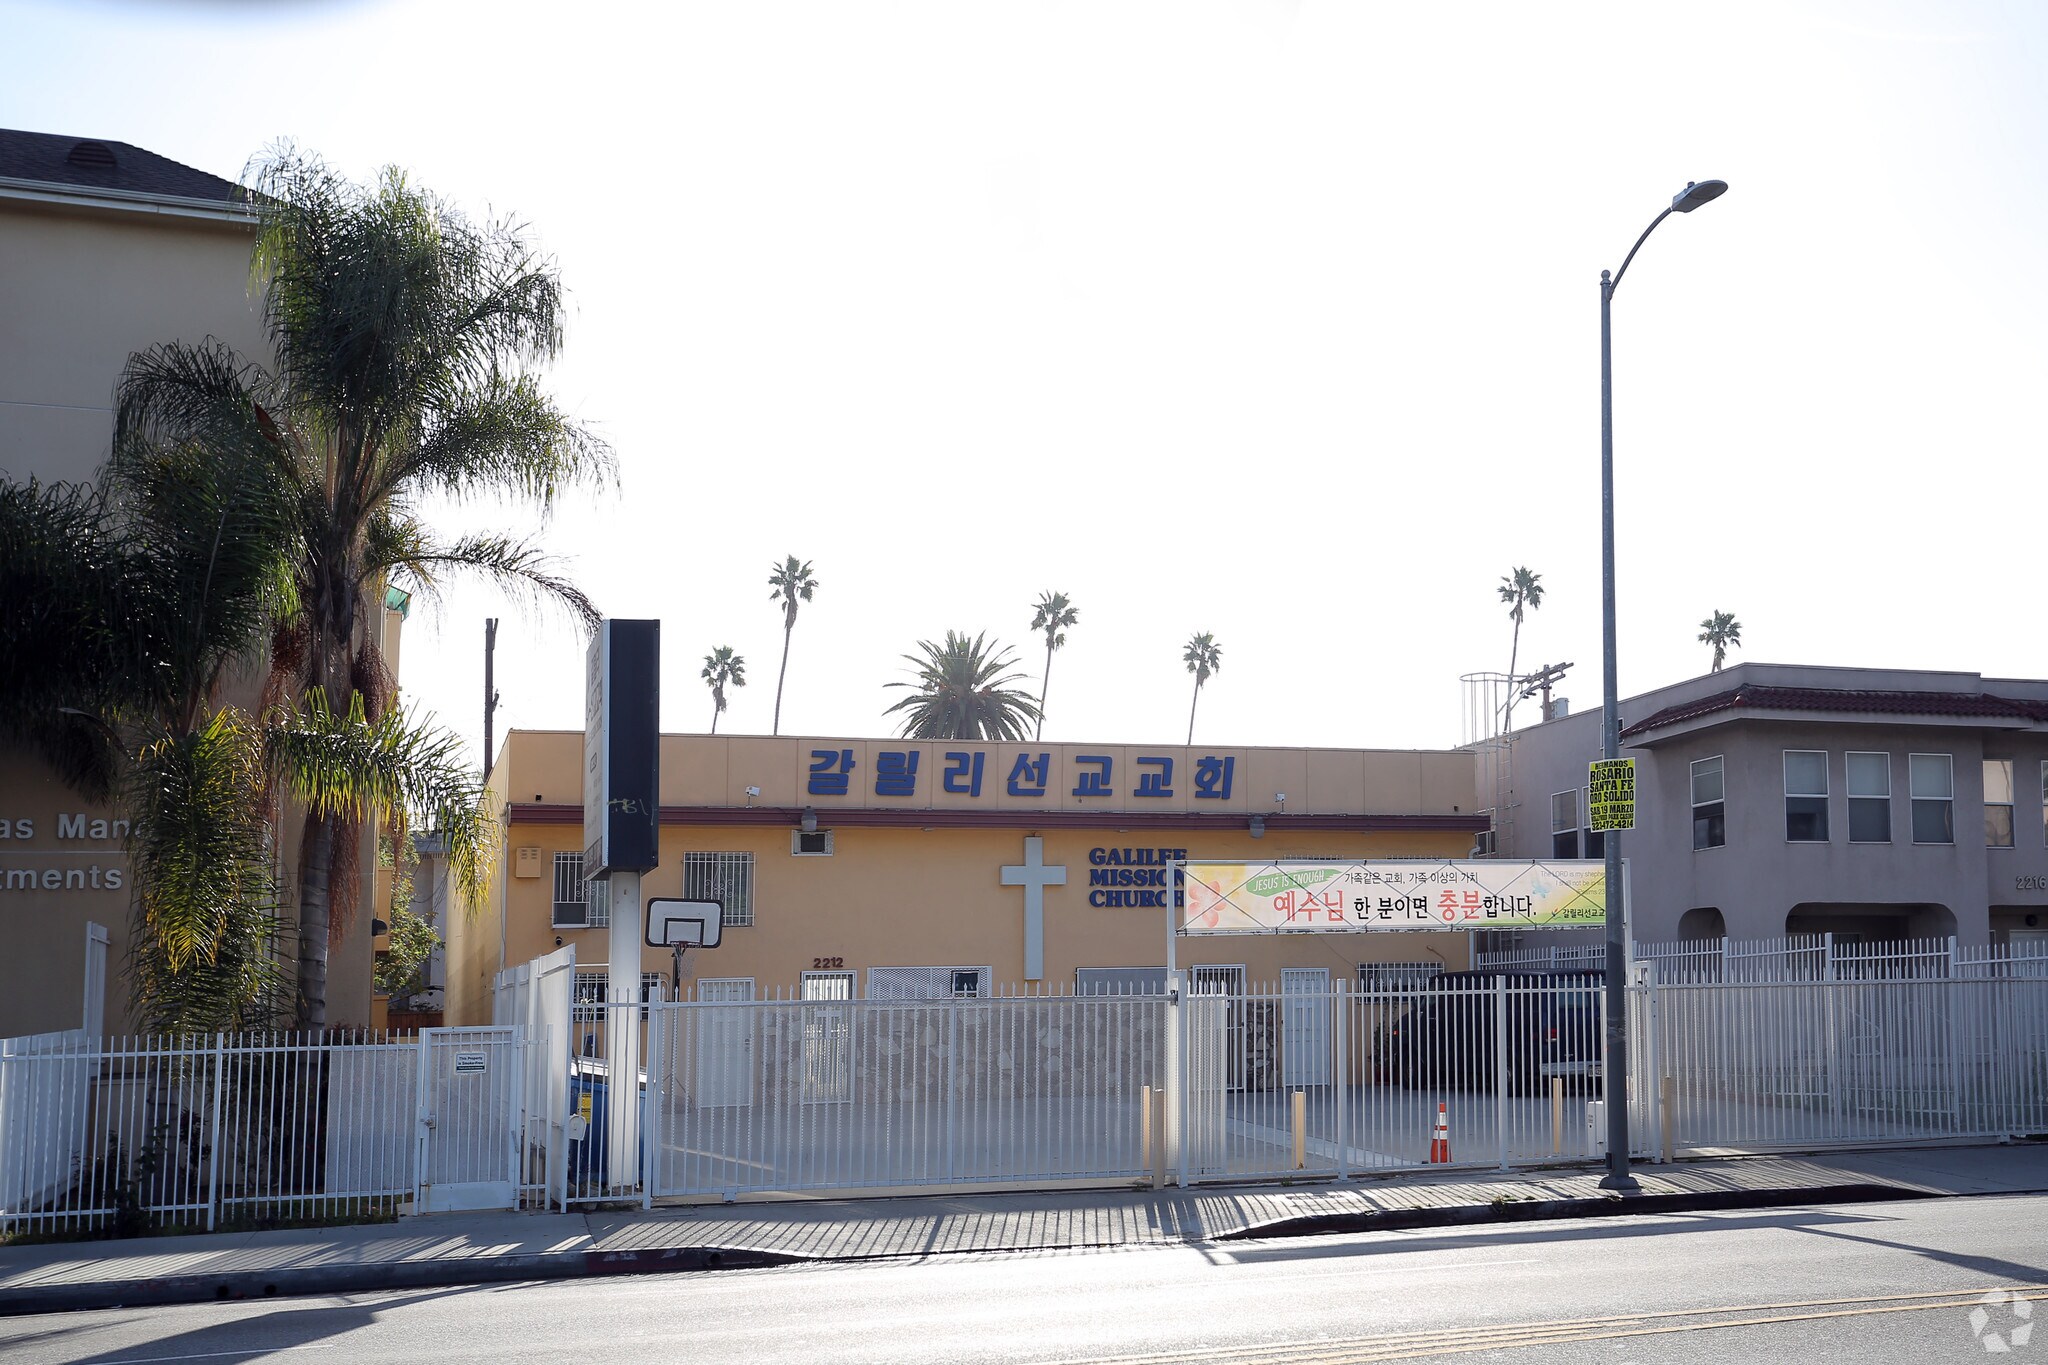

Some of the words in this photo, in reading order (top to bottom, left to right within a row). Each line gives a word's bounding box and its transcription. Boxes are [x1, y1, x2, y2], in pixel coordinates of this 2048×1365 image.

[1595, 760, 1628, 770] HERMANOS
[1590, 767, 1634, 782] ROSARIO
[1590, 780, 1617, 793] SANTA
[1621, 779, 1633, 790] FE
[1604, 790, 1634, 802] SOLIDO
[1601, 805, 1608, 814] 19
[1610, 804, 1634, 813] MARZO
[0, 865, 123, 889] ments
[1253, 876, 1279, 892] JESUS
[1281, 876, 1289, 887] IS
[1292, 870, 1325, 885] ENOUGH
[1345, 872, 1381, 884] 가족같은
[1385, 873, 1405, 884] 교회,
[1409, 872, 1428, 884] 가족
[1430, 872, 1458, 884] 이상의
[1461, 872, 1478, 885] 가치
[2016, 876, 2047, 889] 2216
[1273, 890, 1343, 922] 예수님
[1354, 896, 1371, 920] 한
[1377, 895, 1428, 920] 분이면
[1437, 890, 1537, 921] 충분합니다.
[813, 957, 844, 969] 2212
